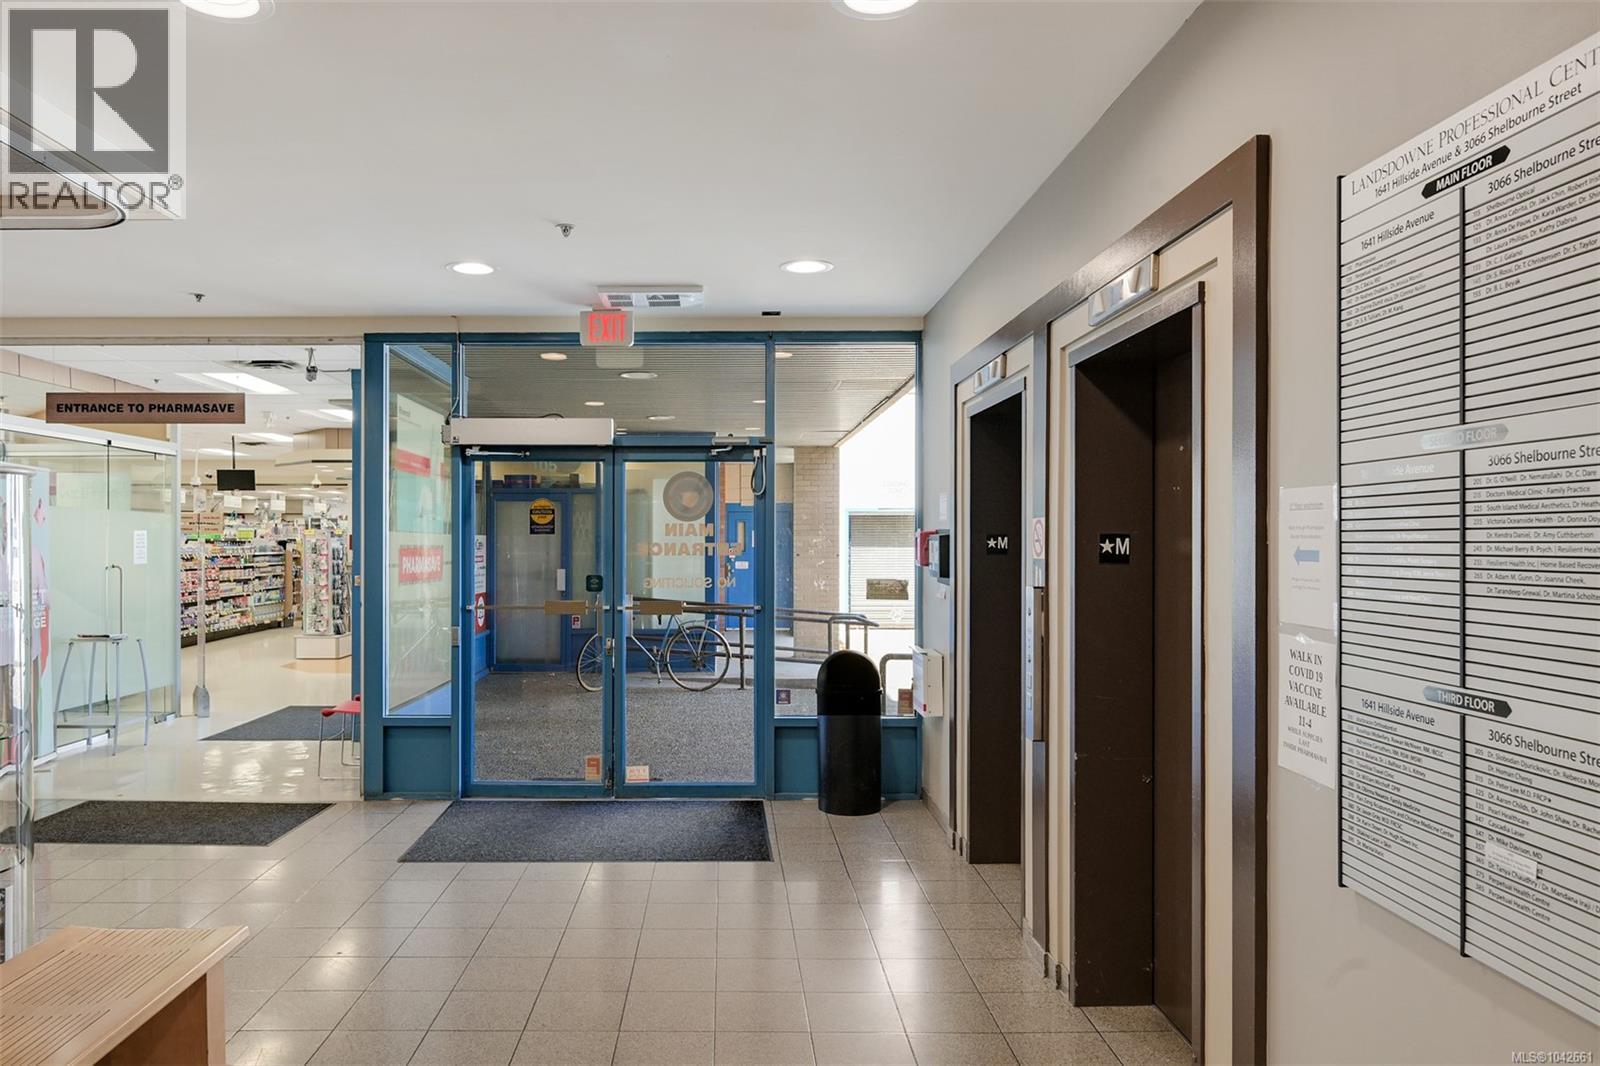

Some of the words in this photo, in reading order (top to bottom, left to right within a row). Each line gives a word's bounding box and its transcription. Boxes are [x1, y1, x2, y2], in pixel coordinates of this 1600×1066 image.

[1352, 136, 1433, 194] LANDSDOWNE
[1439, 76, 1542, 149] PROFESSIONAL
[1375, 179, 1390, 197] 1641
[1392, 165, 1419, 189] Hillside
[1421, 148, 1451, 174] Avenue
[1454, 143, 1461, 157] &
[1464, 130, 1485, 152] 3066
[1488, 99, 1545, 140] Shelbourne
[1548, 81, 1581, 110] Street
[1436, 169, 1459, 191] MAIN
[1461, 154, 1492, 179] FLOOR
[1488, 172, 1511, 194] 3066
[1514, 143, 1575, 182] Shelbourne
[1486, 194, 1514, 213] Shelbourne
[1361, 235, 1375, 250] 1641
[1377, 222, 1403, 243] Hillside
[1405, 208, 1434, 231] Avenue
[588, 313, 626, 343] EXIT
[56, 403, 124, 413] ENTRANCE
[128, 403, 145, 413] TO
[148, 403, 235, 413] PHARMASAVE
[1488, 452, 1511, 466] 3066
[1514, 445, 1575, 464] Shelbourne
[997, 537, 1008, 549] M
[1115, 537, 1130, 555] M
[1290, 648, 1312, 663] WALK
[1314, 654, 1322, 665] IN
[1289, 664, 1314, 680] COVID
[1315, 671, 1323, 682] 19
[1289, 680, 1322, 699] VACCINE
[1361, 697, 1376, 711] 1641
[1378, 701, 1403, 718] Hillside
[1405, 708, 1434, 726] Avenue
[1437, 690, 1462, 705] THIRD
[1464, 695, 1494, 712] FLOOR
[1298, 715, 1312, 728] 11-4
[1489, 728, 1512, 746] 3066
[1514, 734, 1576, 762] Shelbourne
